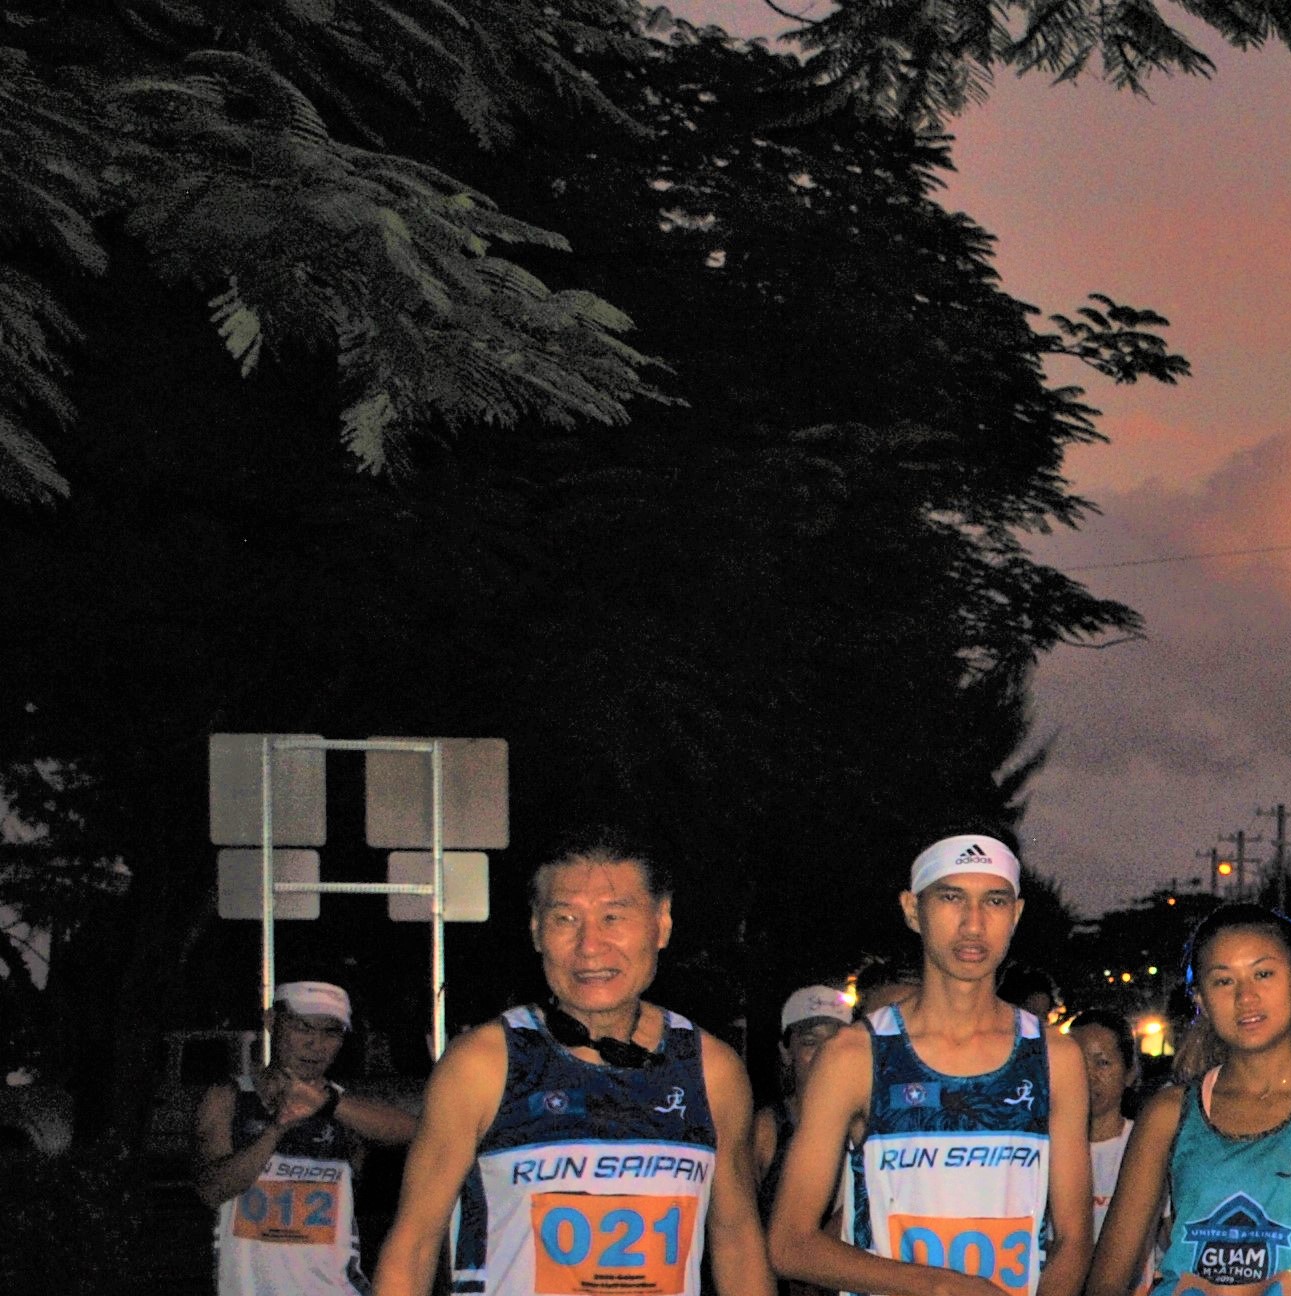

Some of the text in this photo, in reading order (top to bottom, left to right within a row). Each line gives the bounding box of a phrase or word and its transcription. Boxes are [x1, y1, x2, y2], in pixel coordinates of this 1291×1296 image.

[512, 1155, 709, 1184] RUN SAIPAN
[880, 1148, 938, 1171] RUN
[240, 1185, 335, 1227] 012
[541, 1206, 681, 1268] 021
[1191, 1229, 1228, 1237] UNITED
[901, 1226, 1032, 1289] 003
[1202, 1247, 1266, 1267] GUAM
